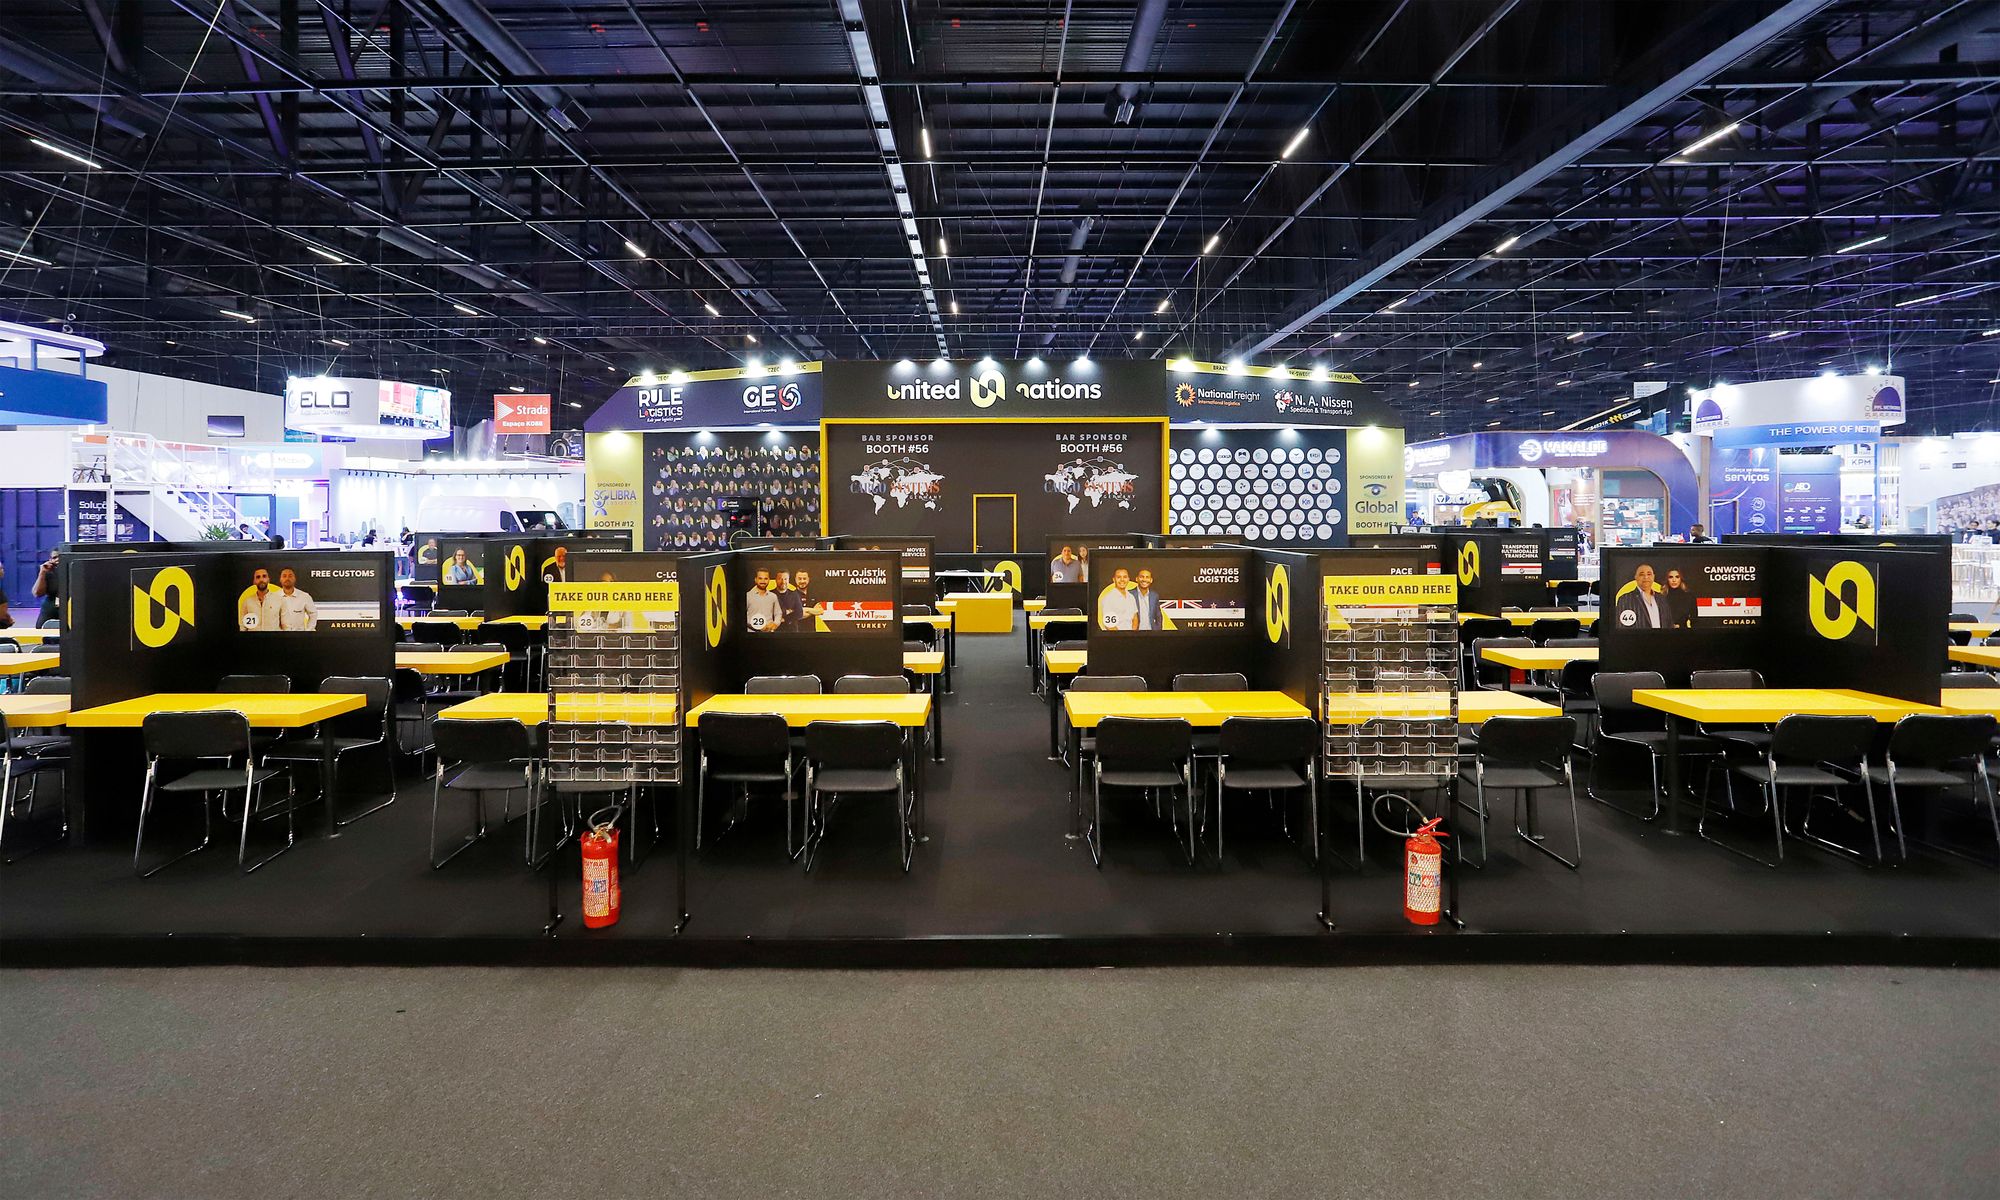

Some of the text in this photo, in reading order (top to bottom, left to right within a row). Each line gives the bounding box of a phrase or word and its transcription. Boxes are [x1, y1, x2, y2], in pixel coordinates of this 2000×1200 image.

[887, 378, 1102, 400] united nations
[638, 387, 684, 407] RULE
[1295, 394, 1353, 409] N. A. Nissen
[516, 404, 549, 415] Strada
[1319, 407, 1343, 415] Transport
[1769, 428, 1792, 437] THE
[1794, 426, 1837, 435] POWER
[1839, 425, 1853, 433] OF
[866, 444, 929, 454] BOOTH #56
[1060, 444, 1123, 453] BOOTH #56
[1724, 472, 1770, 484] serviços
[1355, 501, 1398, 514] Global
[594, 520, 635, 528] BOOTH #12
[310, 570, 375, 578] FREE CUSTOMS
[825, 568, 887, 577] NMT LOJİSTİK
[1199, 567, 1240, 575] NOW365
[1390, 567, 1413, 575] PACE
[1703, 566, 1756, 574] CANWORLD
[849, 575, 887, 585] ANONİM
[1193, 575, 1240, 583] LOGISTICS
[1709, 573, 1756, 582] LOGISTICS
[1329, 584, 1452, 595] TAKE OUR CARD HERE
[555, 592, 673, 601] TAKE OUR CARD HERE
[854, 611, 875, 619] NMT
[1104, 615, 1117, 624] 36
[1622, 613, 1635, 622] 44
[246, 617, 256, 625] 21
[580, 618, 592, 626] 28
[752, 617, 765, 626] 29
